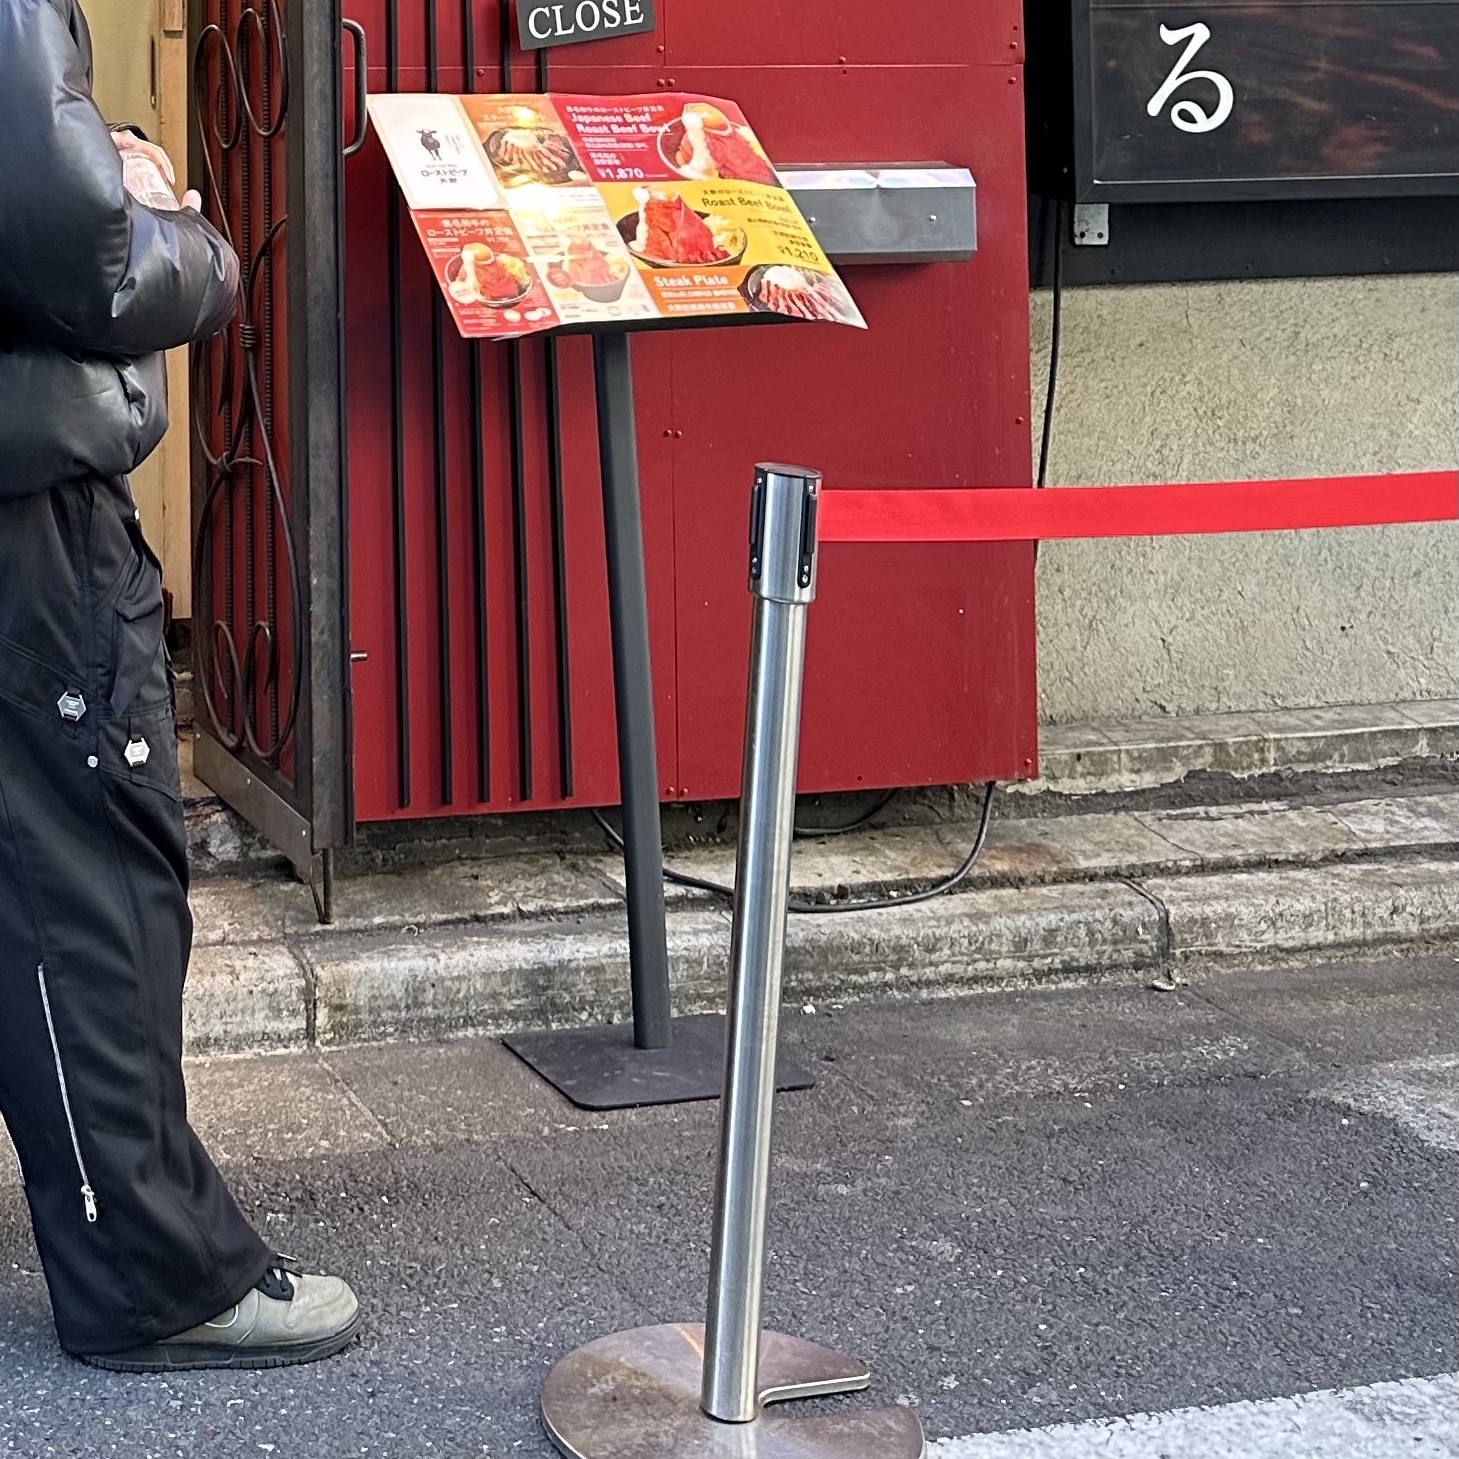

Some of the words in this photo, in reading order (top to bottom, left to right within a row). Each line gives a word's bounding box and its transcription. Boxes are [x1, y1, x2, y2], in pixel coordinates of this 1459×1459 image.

[572, 113, 623, 124] Japanese
[624, 112, 651, 122] Beef
[576, 124, 610, 133] Roast
[610, 124, 638, 133] Beef
[702, 197, 737, 207] Roast
[738, 197, 764, 208] Beef
[653, 275, 692, 287] Steak
[693, 274, 729, 285] Plate
